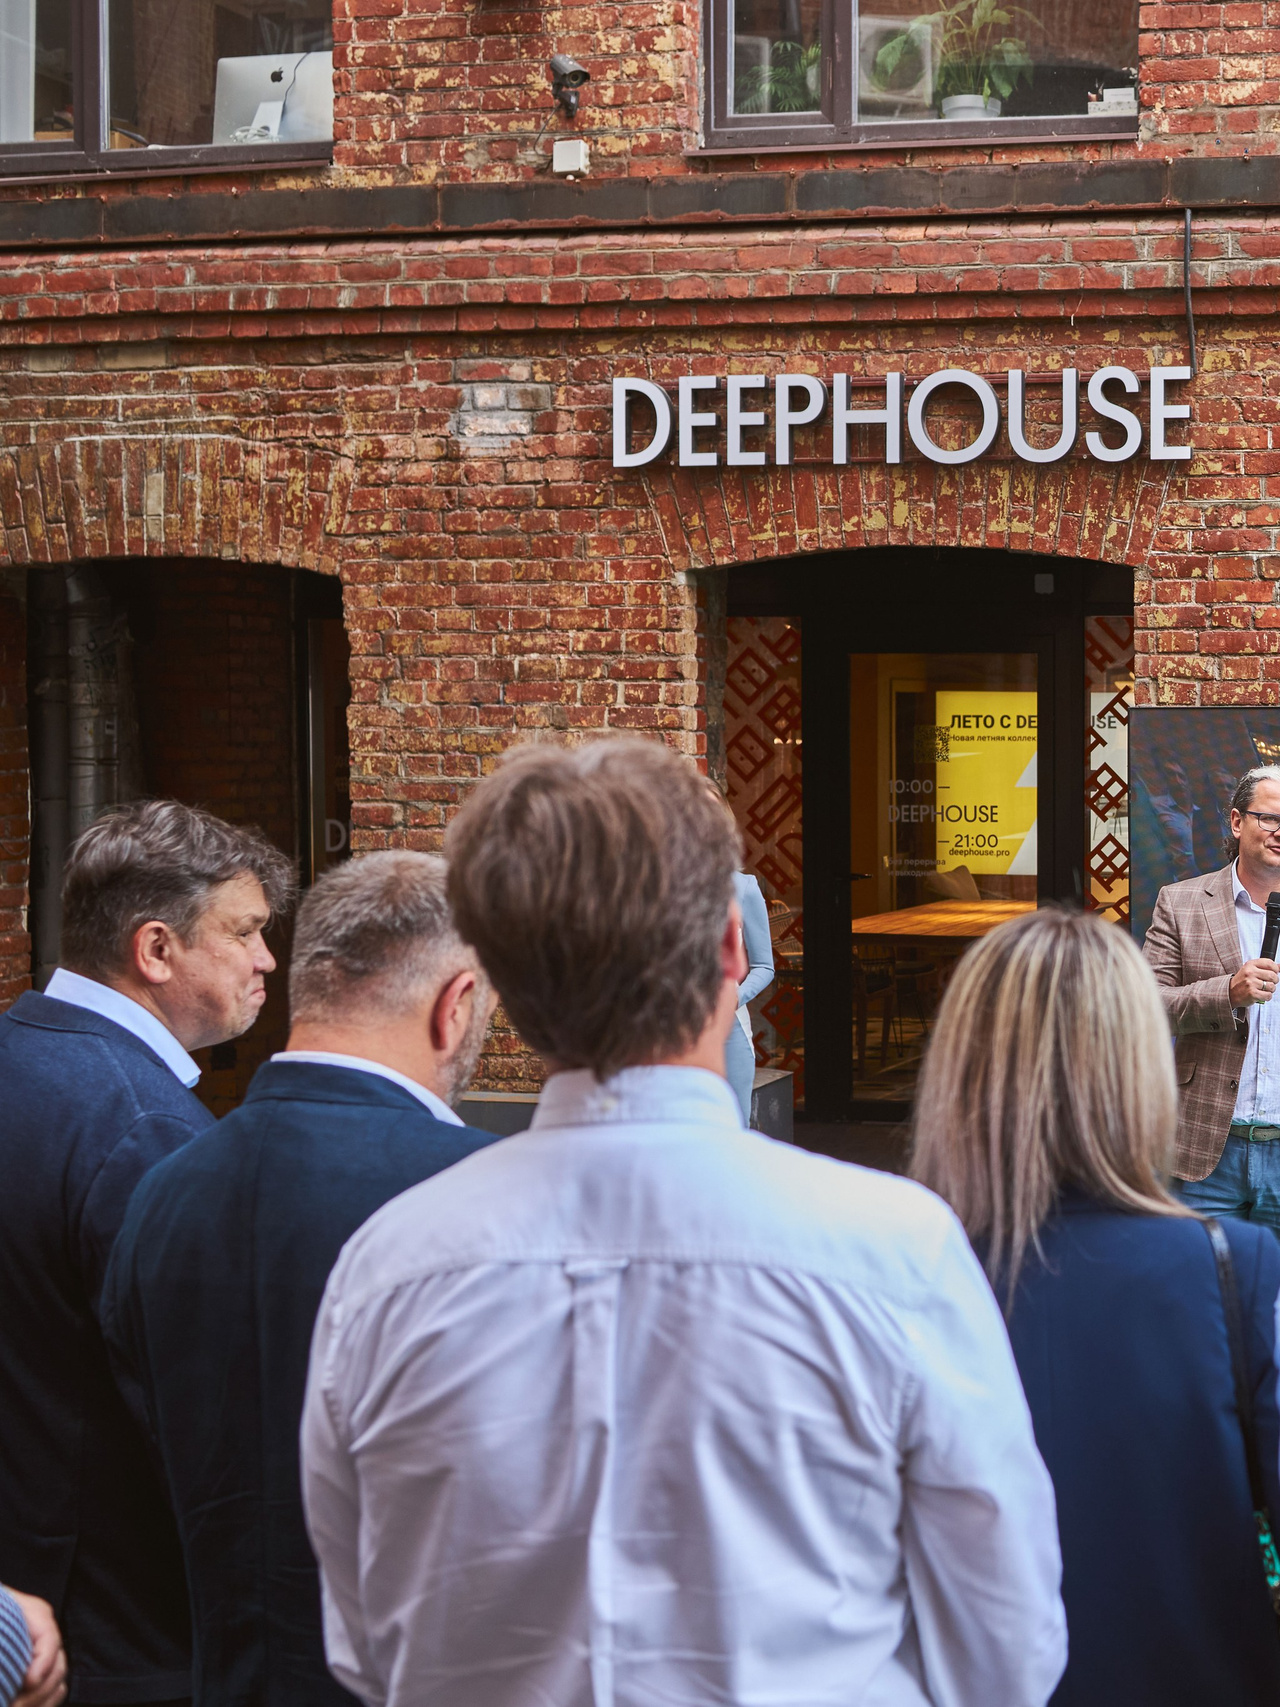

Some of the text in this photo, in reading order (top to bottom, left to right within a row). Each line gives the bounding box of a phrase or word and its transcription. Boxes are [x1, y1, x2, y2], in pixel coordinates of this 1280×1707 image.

[612, 365, 1194, 468] DEEPHOUSE
[950, 715, 995, 729] ЛЕТО
[976, 734, 1006, 742] летняя
[888, 779, 934, 794] 10:00
[888, 805, 998, 823] DEEPHOUSE
[954, 834, 998, 848] 21:00
[949, 848, 1010, 857] deephouse.pro
